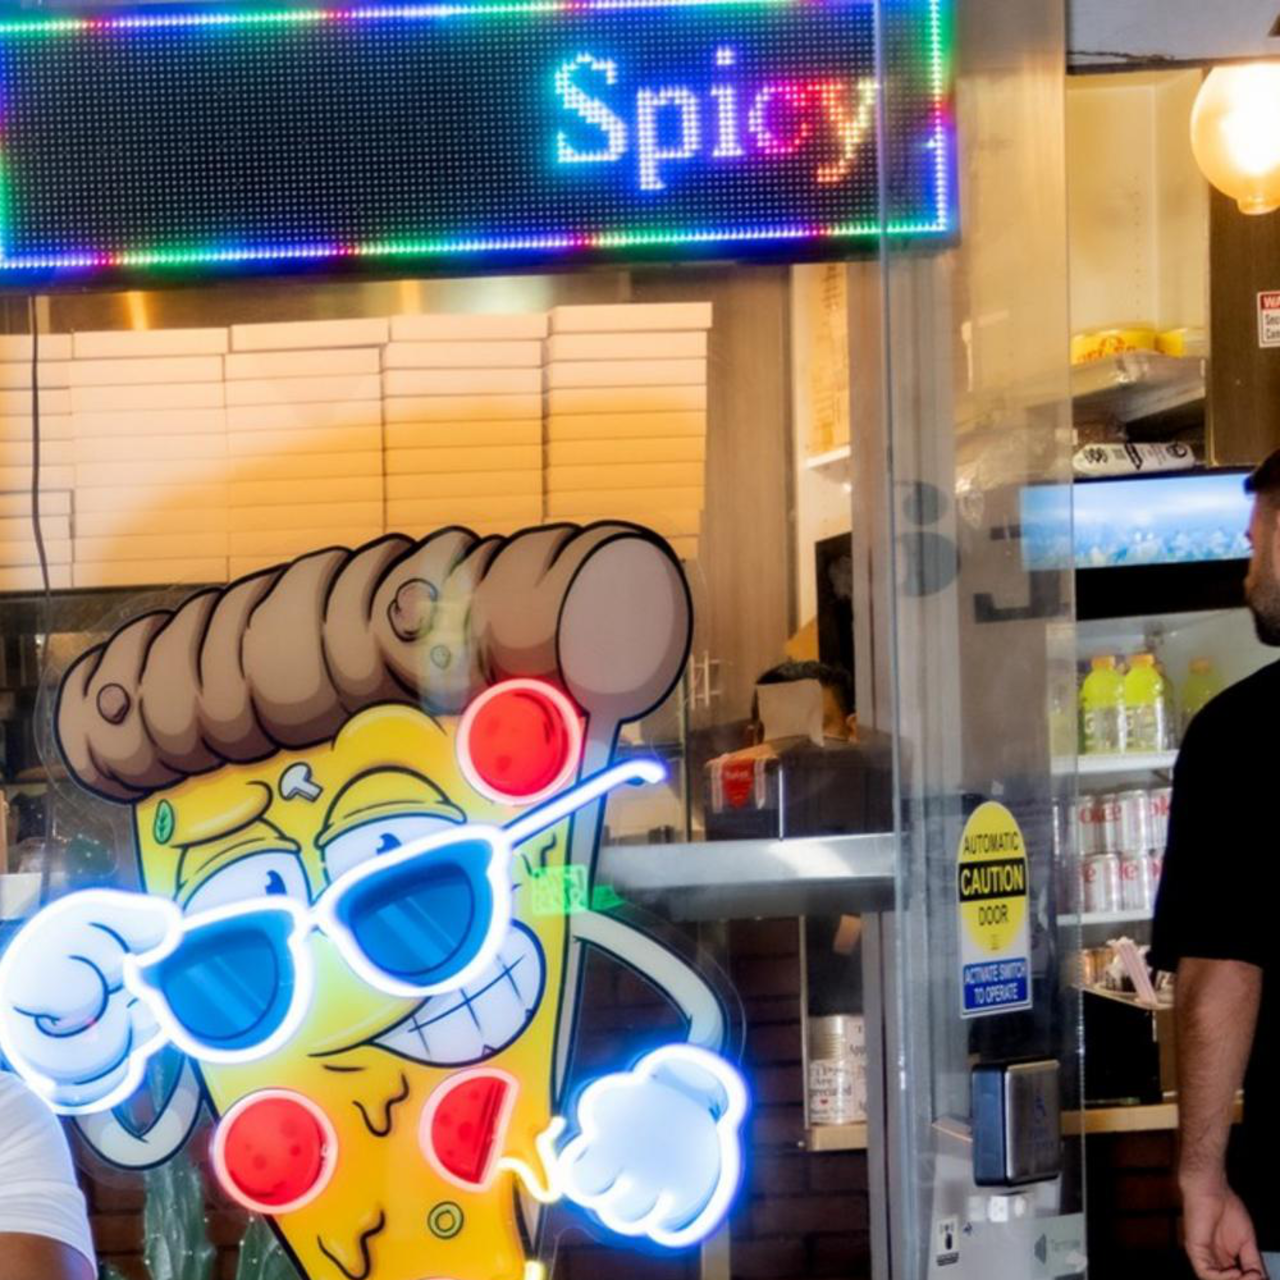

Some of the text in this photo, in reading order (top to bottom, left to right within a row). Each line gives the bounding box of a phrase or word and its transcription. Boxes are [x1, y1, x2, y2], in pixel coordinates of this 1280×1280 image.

[554, 45, 879, 190] Spicy
[963, 830, 1020, 855] AUTOMATIC
[961, 864, 1024, 896] CAUTION
[978, 903, 1009, 926] DOOR
